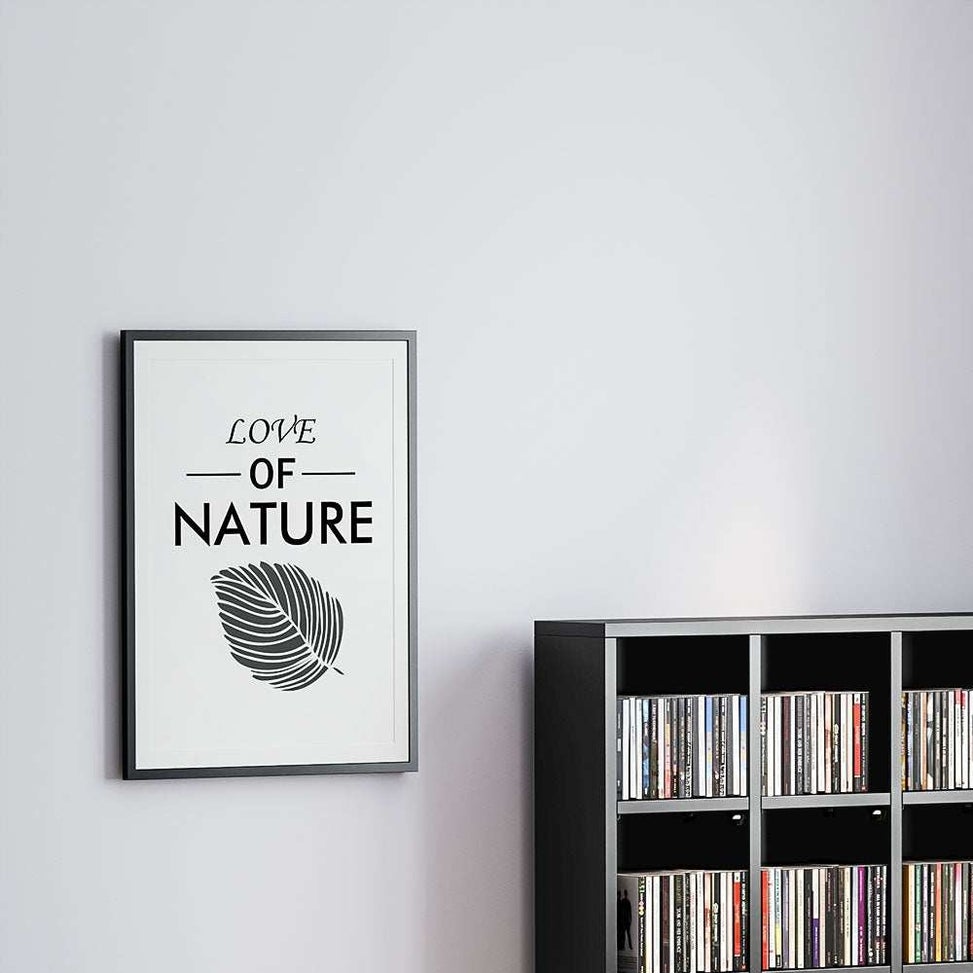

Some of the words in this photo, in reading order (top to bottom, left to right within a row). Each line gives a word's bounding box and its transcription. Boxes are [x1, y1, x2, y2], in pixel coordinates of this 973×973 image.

[226, 414, 316, 444] LOVE
[250, 458, 295, 489] OF
[175, 501, 372, 546] NATURE
